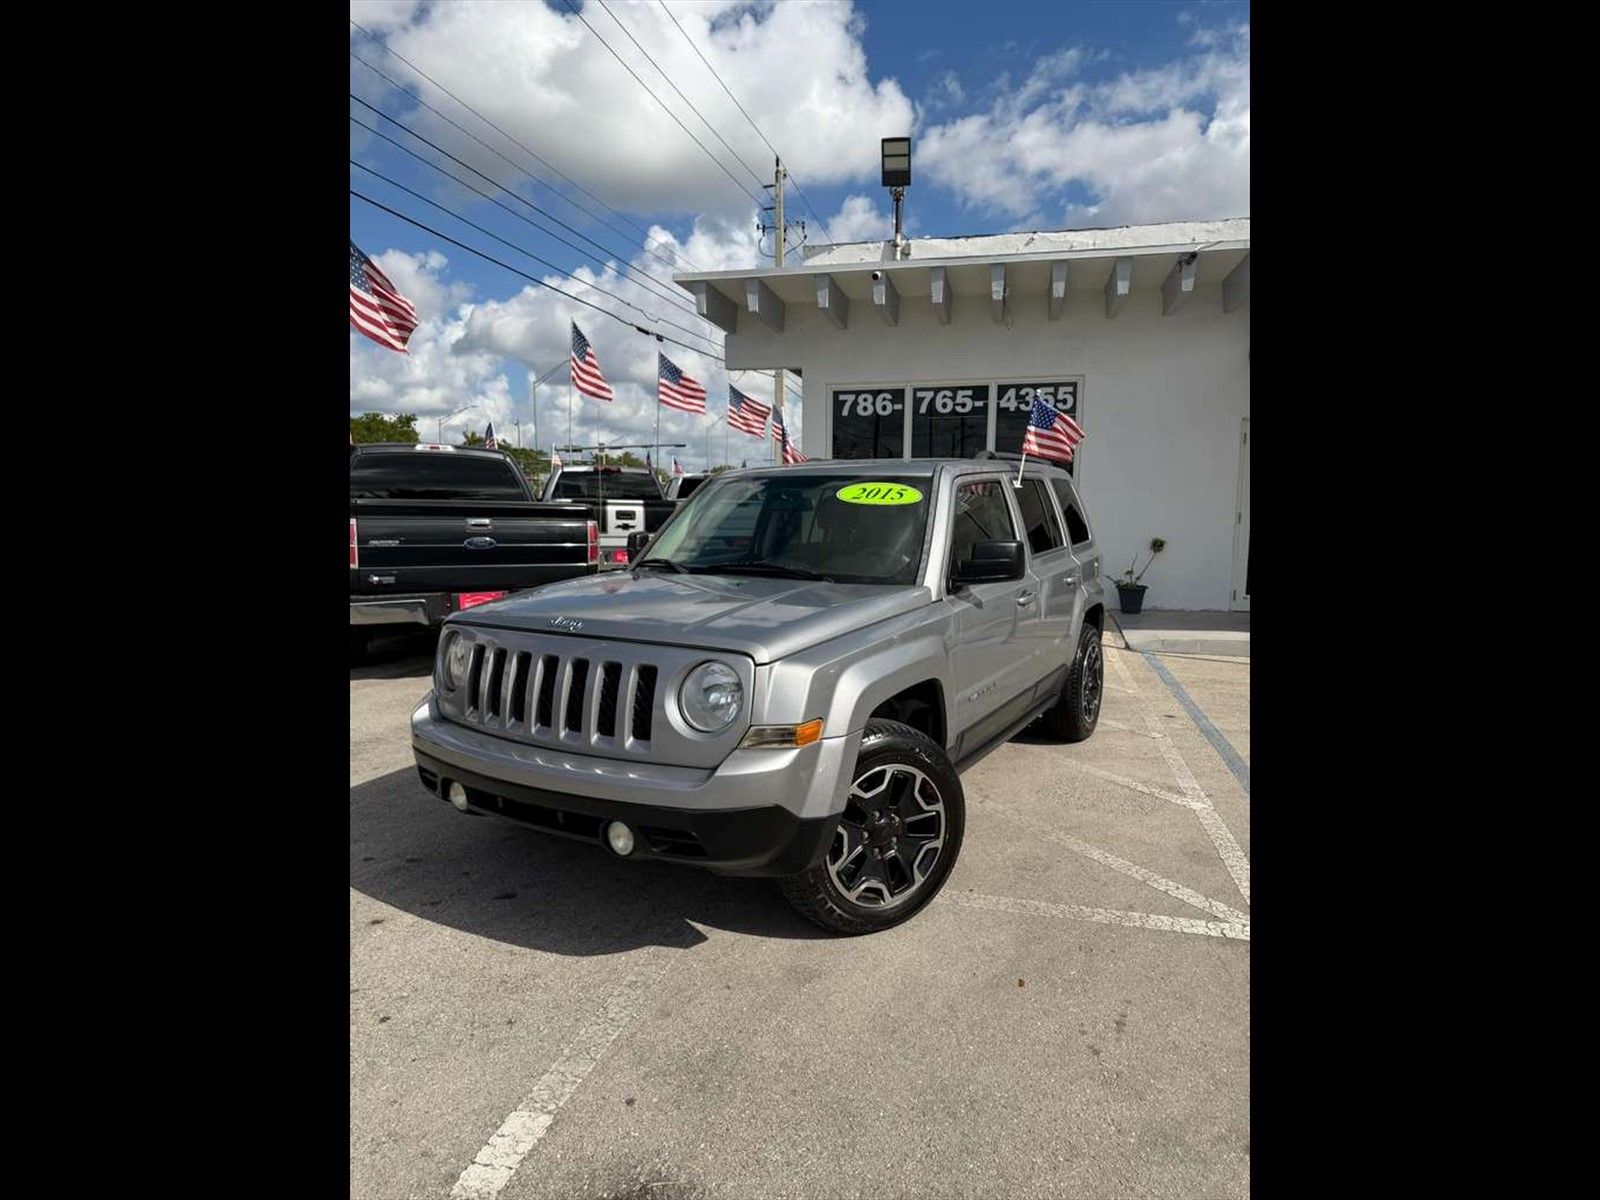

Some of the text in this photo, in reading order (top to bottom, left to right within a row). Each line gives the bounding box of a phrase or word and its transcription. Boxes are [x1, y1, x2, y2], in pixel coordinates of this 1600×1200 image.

[838, 386, 1074, 416] 786- 765- 4355
[852, 487, 908, 500] 2015
